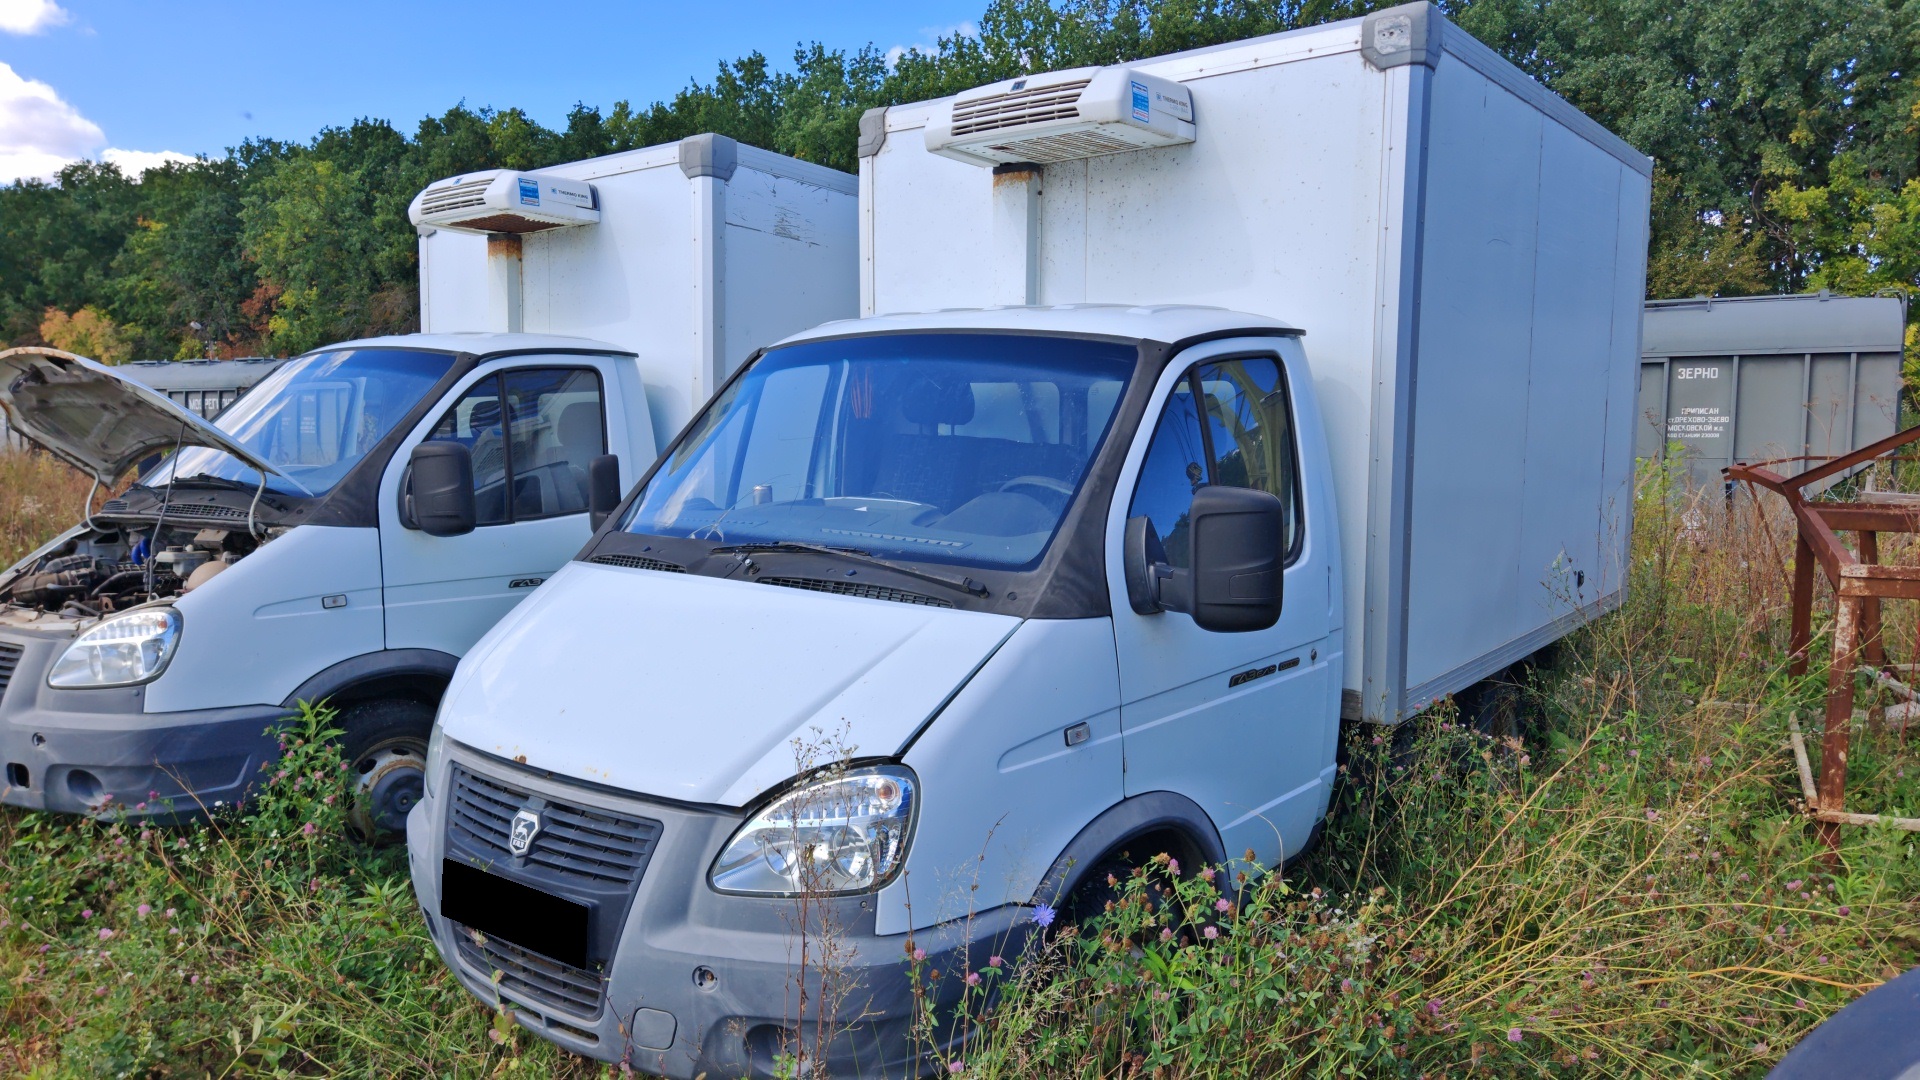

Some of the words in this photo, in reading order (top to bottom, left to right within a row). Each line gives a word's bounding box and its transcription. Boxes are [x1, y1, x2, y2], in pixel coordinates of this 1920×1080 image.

[1677, 367, 1719, 379] ЗЕРНО
[1681, 407, 1720, 415] ПРИПИСАН
[1667, 423, 1713, 432] МОСКОВСКОЙ
